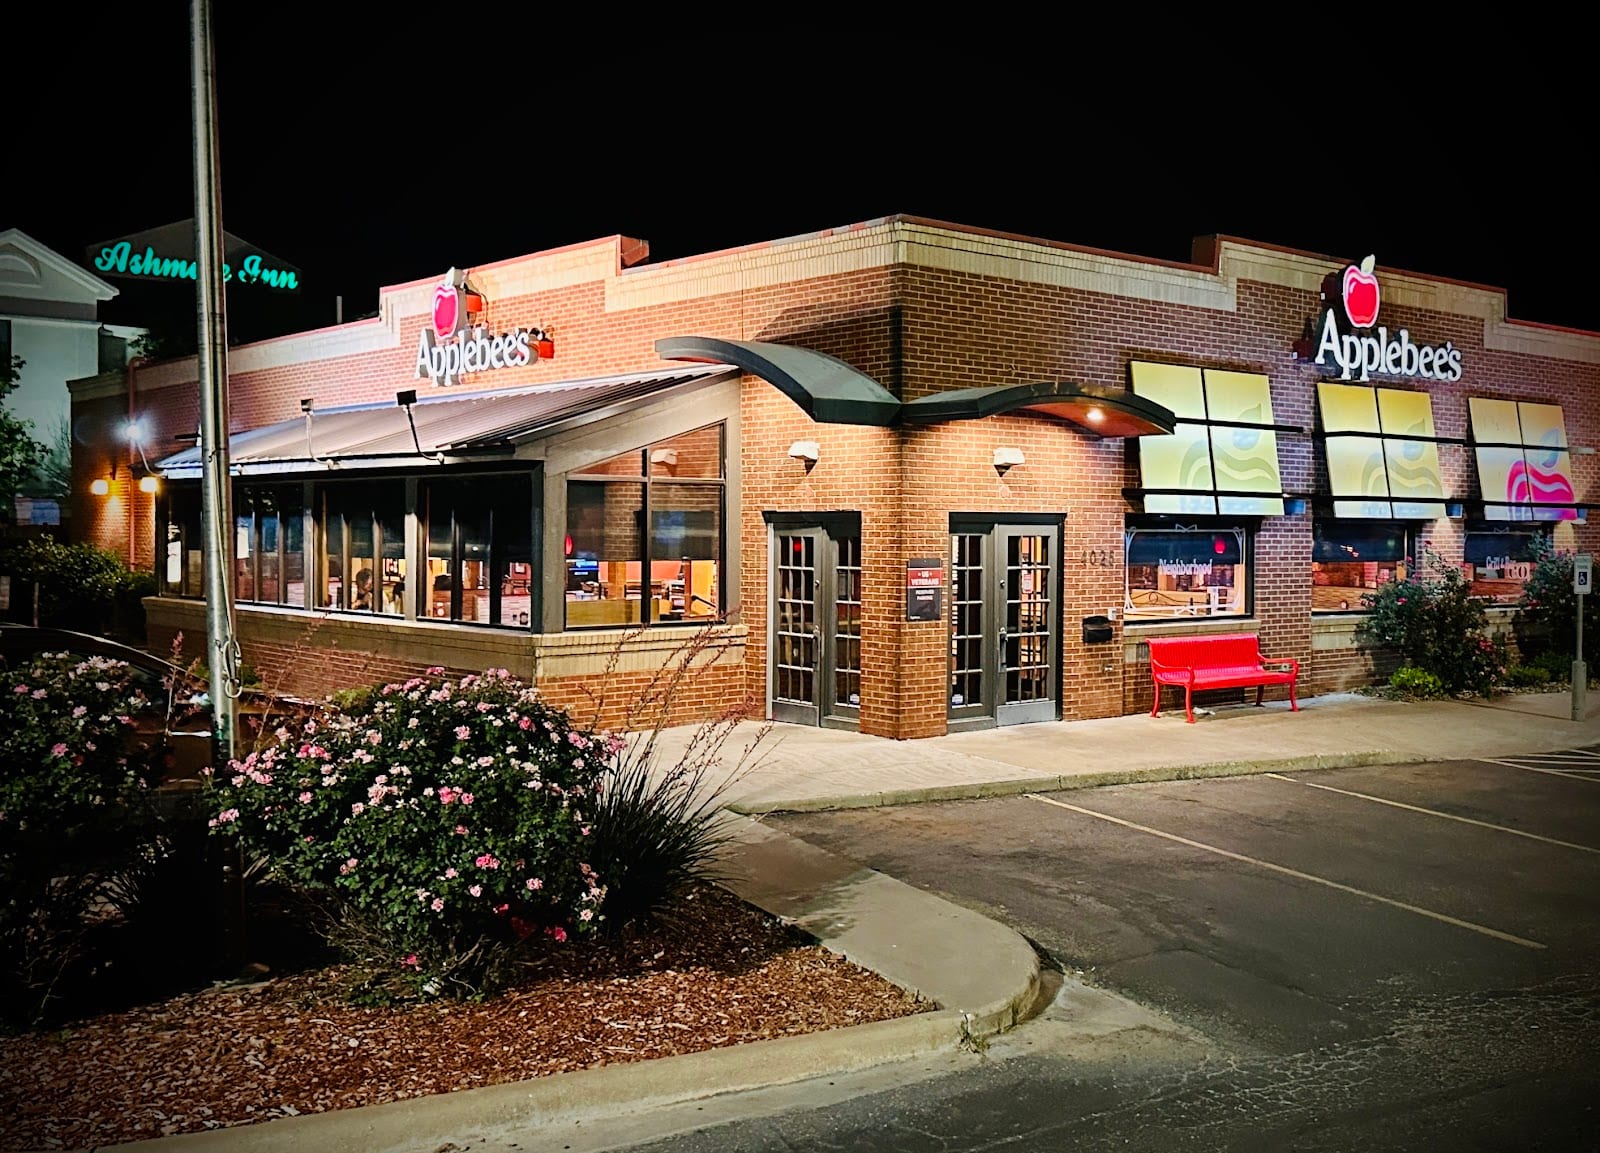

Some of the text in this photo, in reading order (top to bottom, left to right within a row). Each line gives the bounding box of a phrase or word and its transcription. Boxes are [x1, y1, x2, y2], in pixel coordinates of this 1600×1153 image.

[94, 241, 298, 289] Ashme Inn
[414, 328, 530, 387] Applebee's
[1315, 308, 1462, 382] Applebee's
[1159, 558, 1213, 578] Neighborhood
